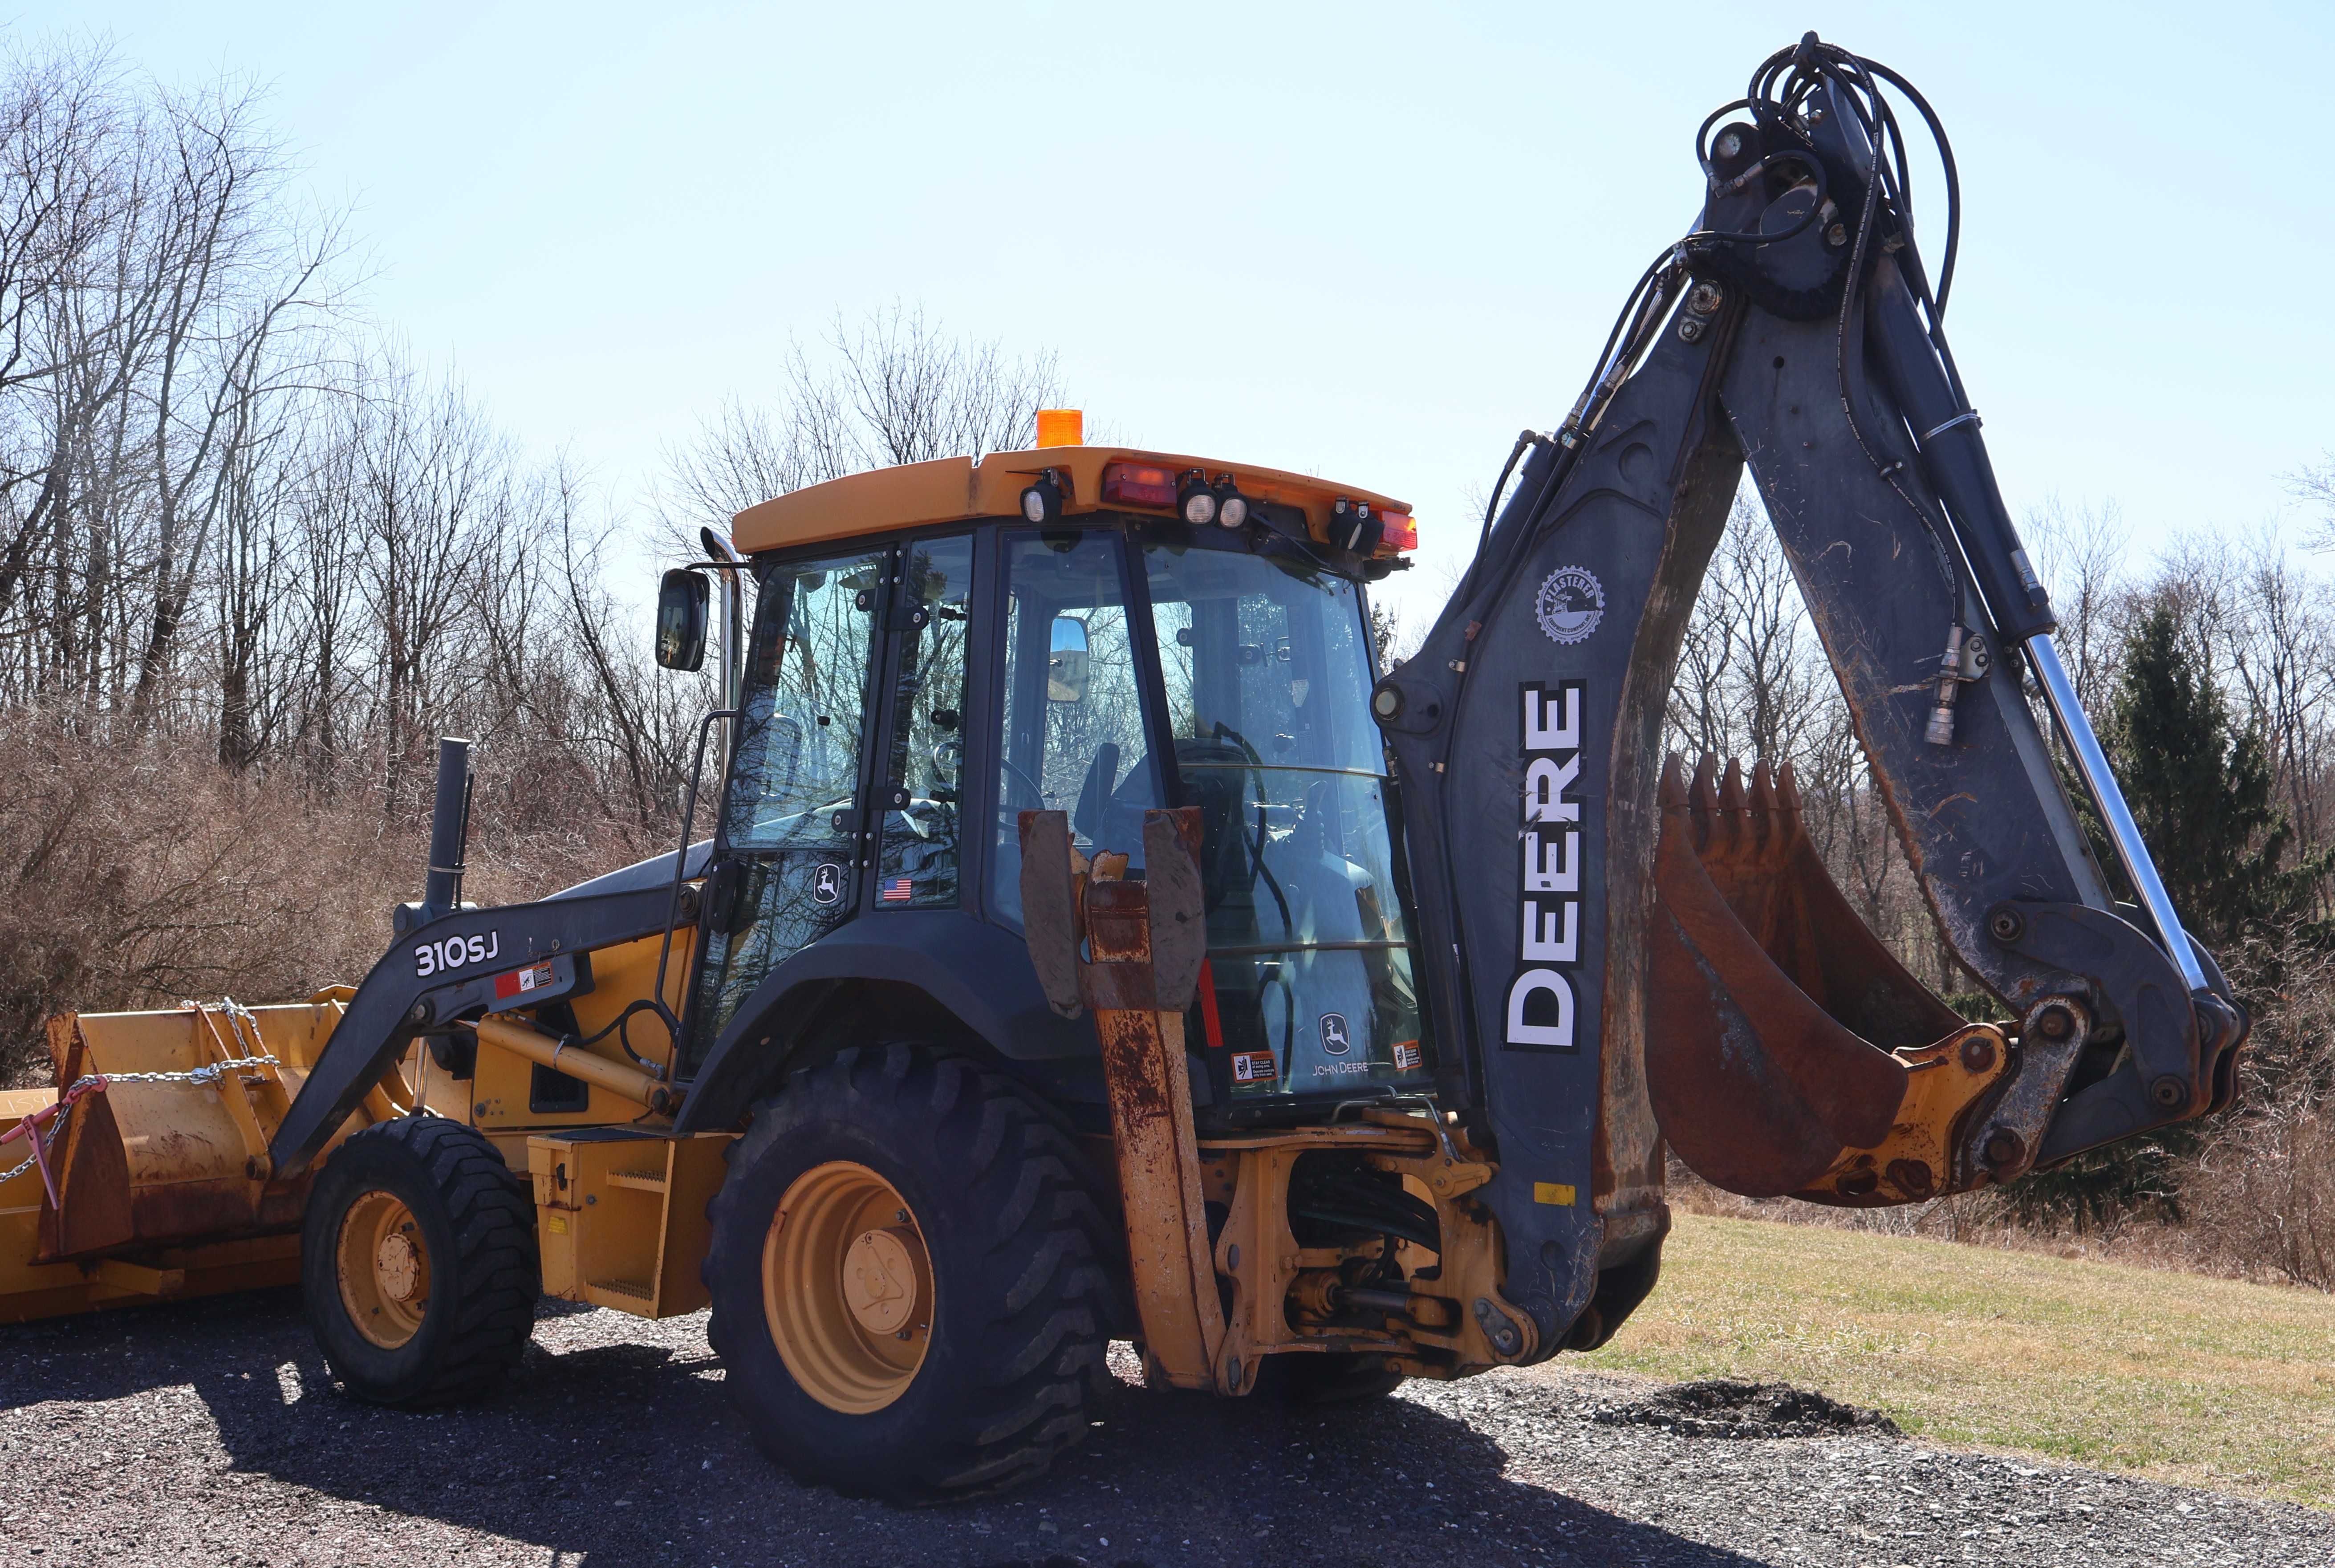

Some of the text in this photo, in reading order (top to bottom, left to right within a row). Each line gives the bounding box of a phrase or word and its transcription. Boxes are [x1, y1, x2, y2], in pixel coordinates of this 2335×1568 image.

[1545, 576, 1594, 602] PLASTERER
[1548, 617, 1567, 633] EQUIPMENT
[1507, 688, 1580, 1046] DEERE
[415, 930, 499, 977] 310SJ
[1312, 1061, 1369, 1076] JOHN DEERE
